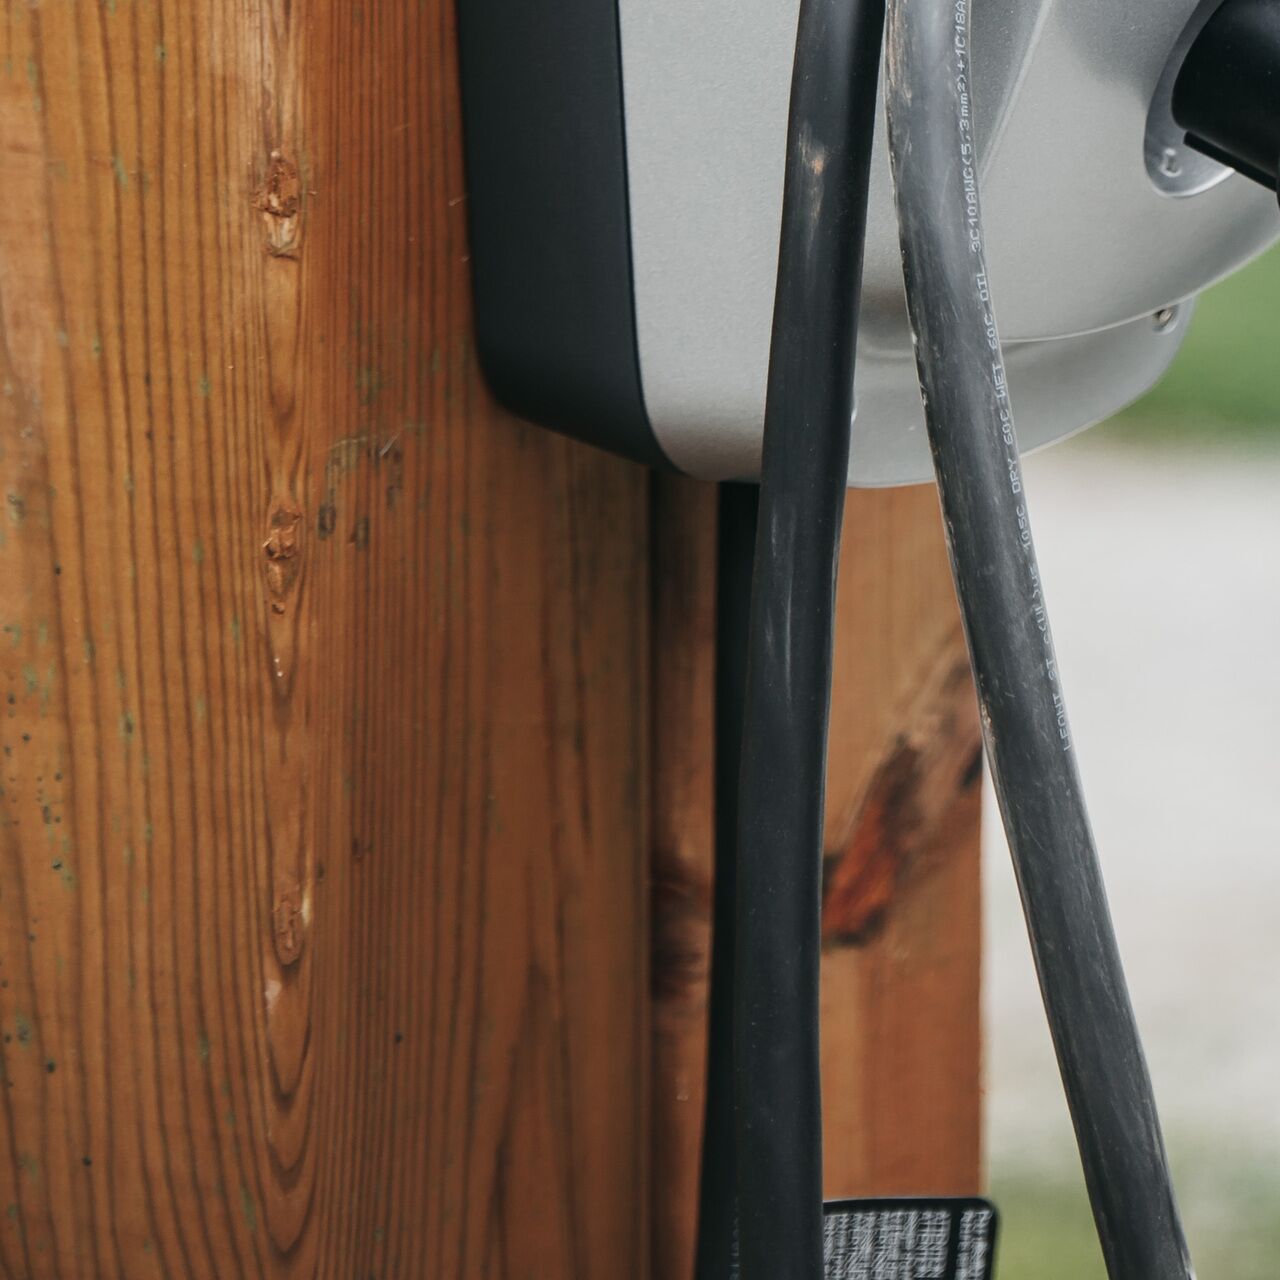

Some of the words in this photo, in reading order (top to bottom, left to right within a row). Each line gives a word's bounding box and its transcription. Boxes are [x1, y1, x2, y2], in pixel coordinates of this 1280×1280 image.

[975, 264, 990, 302] OIL
[984, 312, 999, 351] 60C
[991, 362, 1006, 399] WET
[999, 407, 1014, 445] 60C
[1007, 457, 1022, 494] DRY
[1016, 504, 1032, 550] 105C
